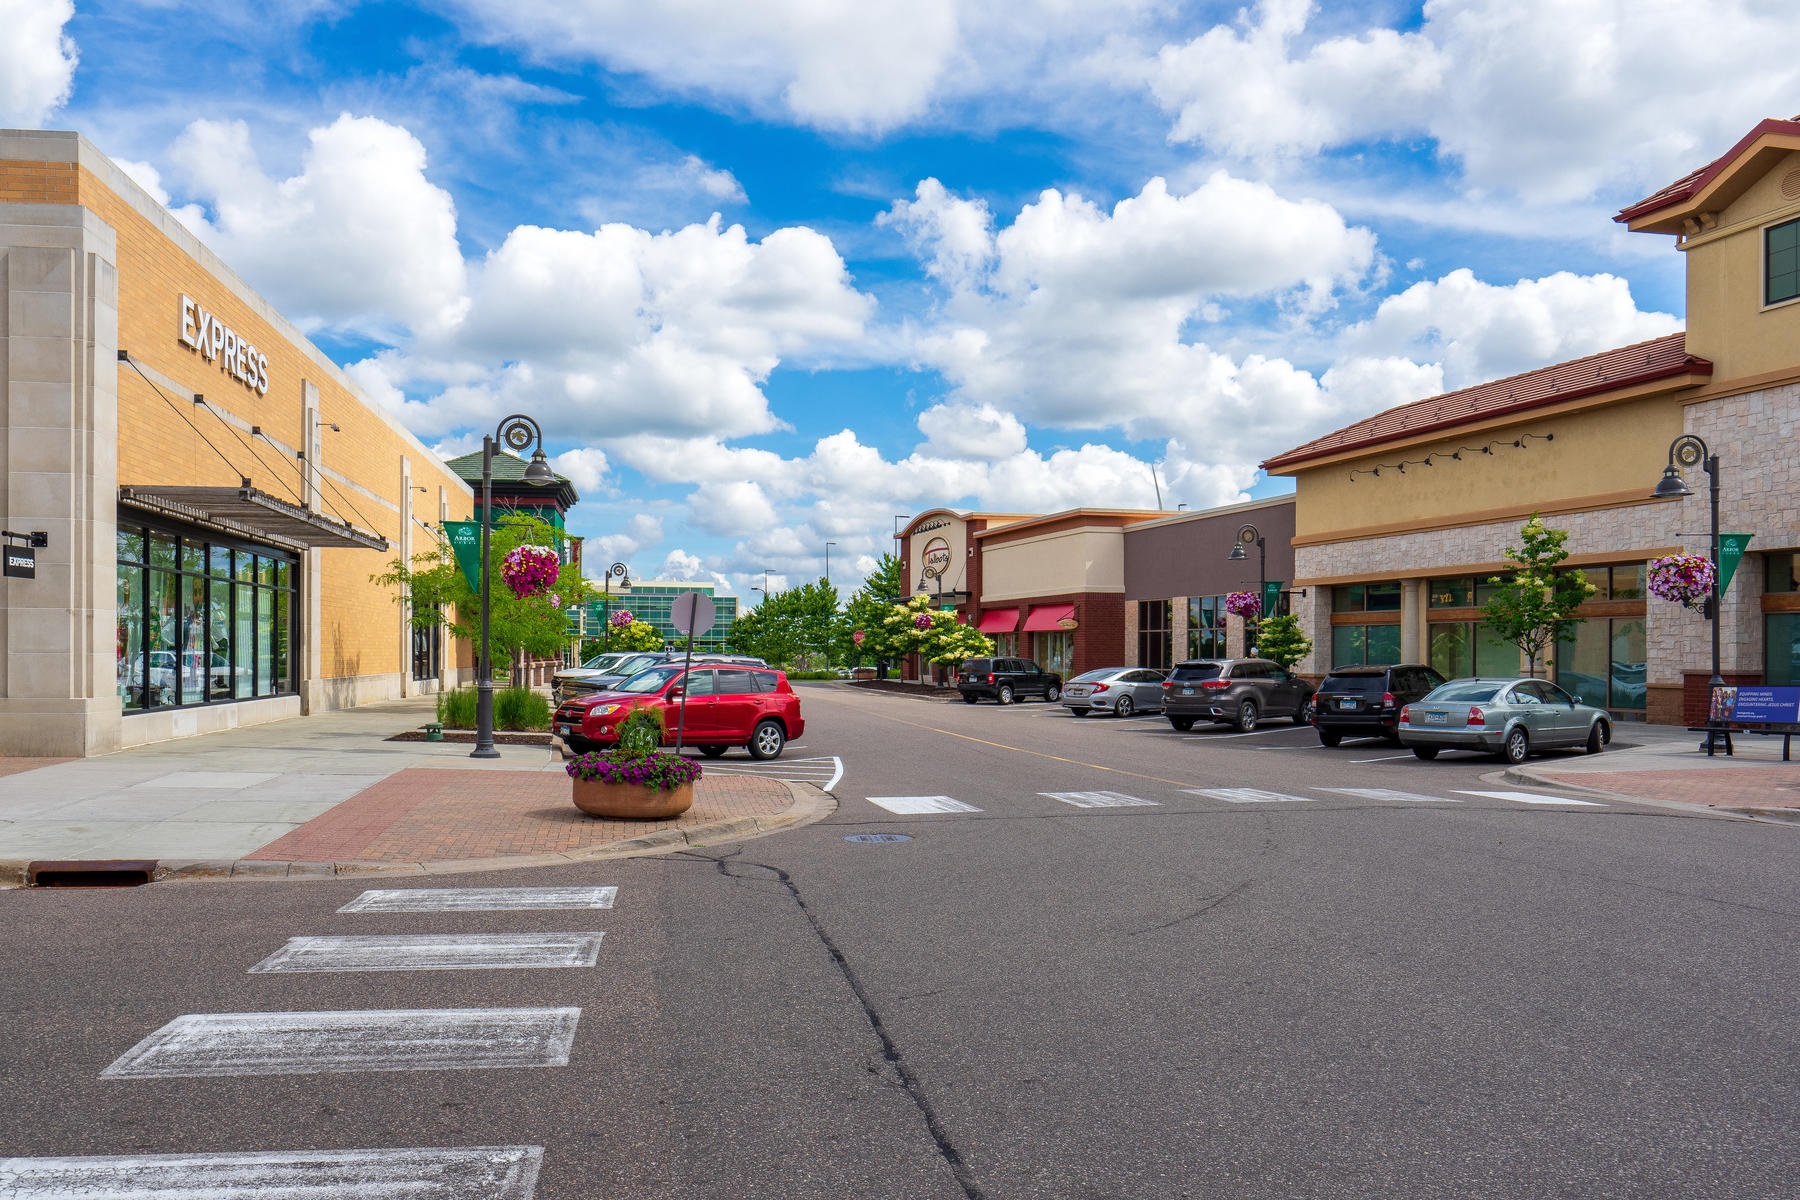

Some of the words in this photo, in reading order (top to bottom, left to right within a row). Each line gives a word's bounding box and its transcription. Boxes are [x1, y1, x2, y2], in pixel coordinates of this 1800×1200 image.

[178, 293, 269, 396] EXPRESS
[8, 556, 35, 568] EXPRESS
[925, 547, 949, 566] Talbots
